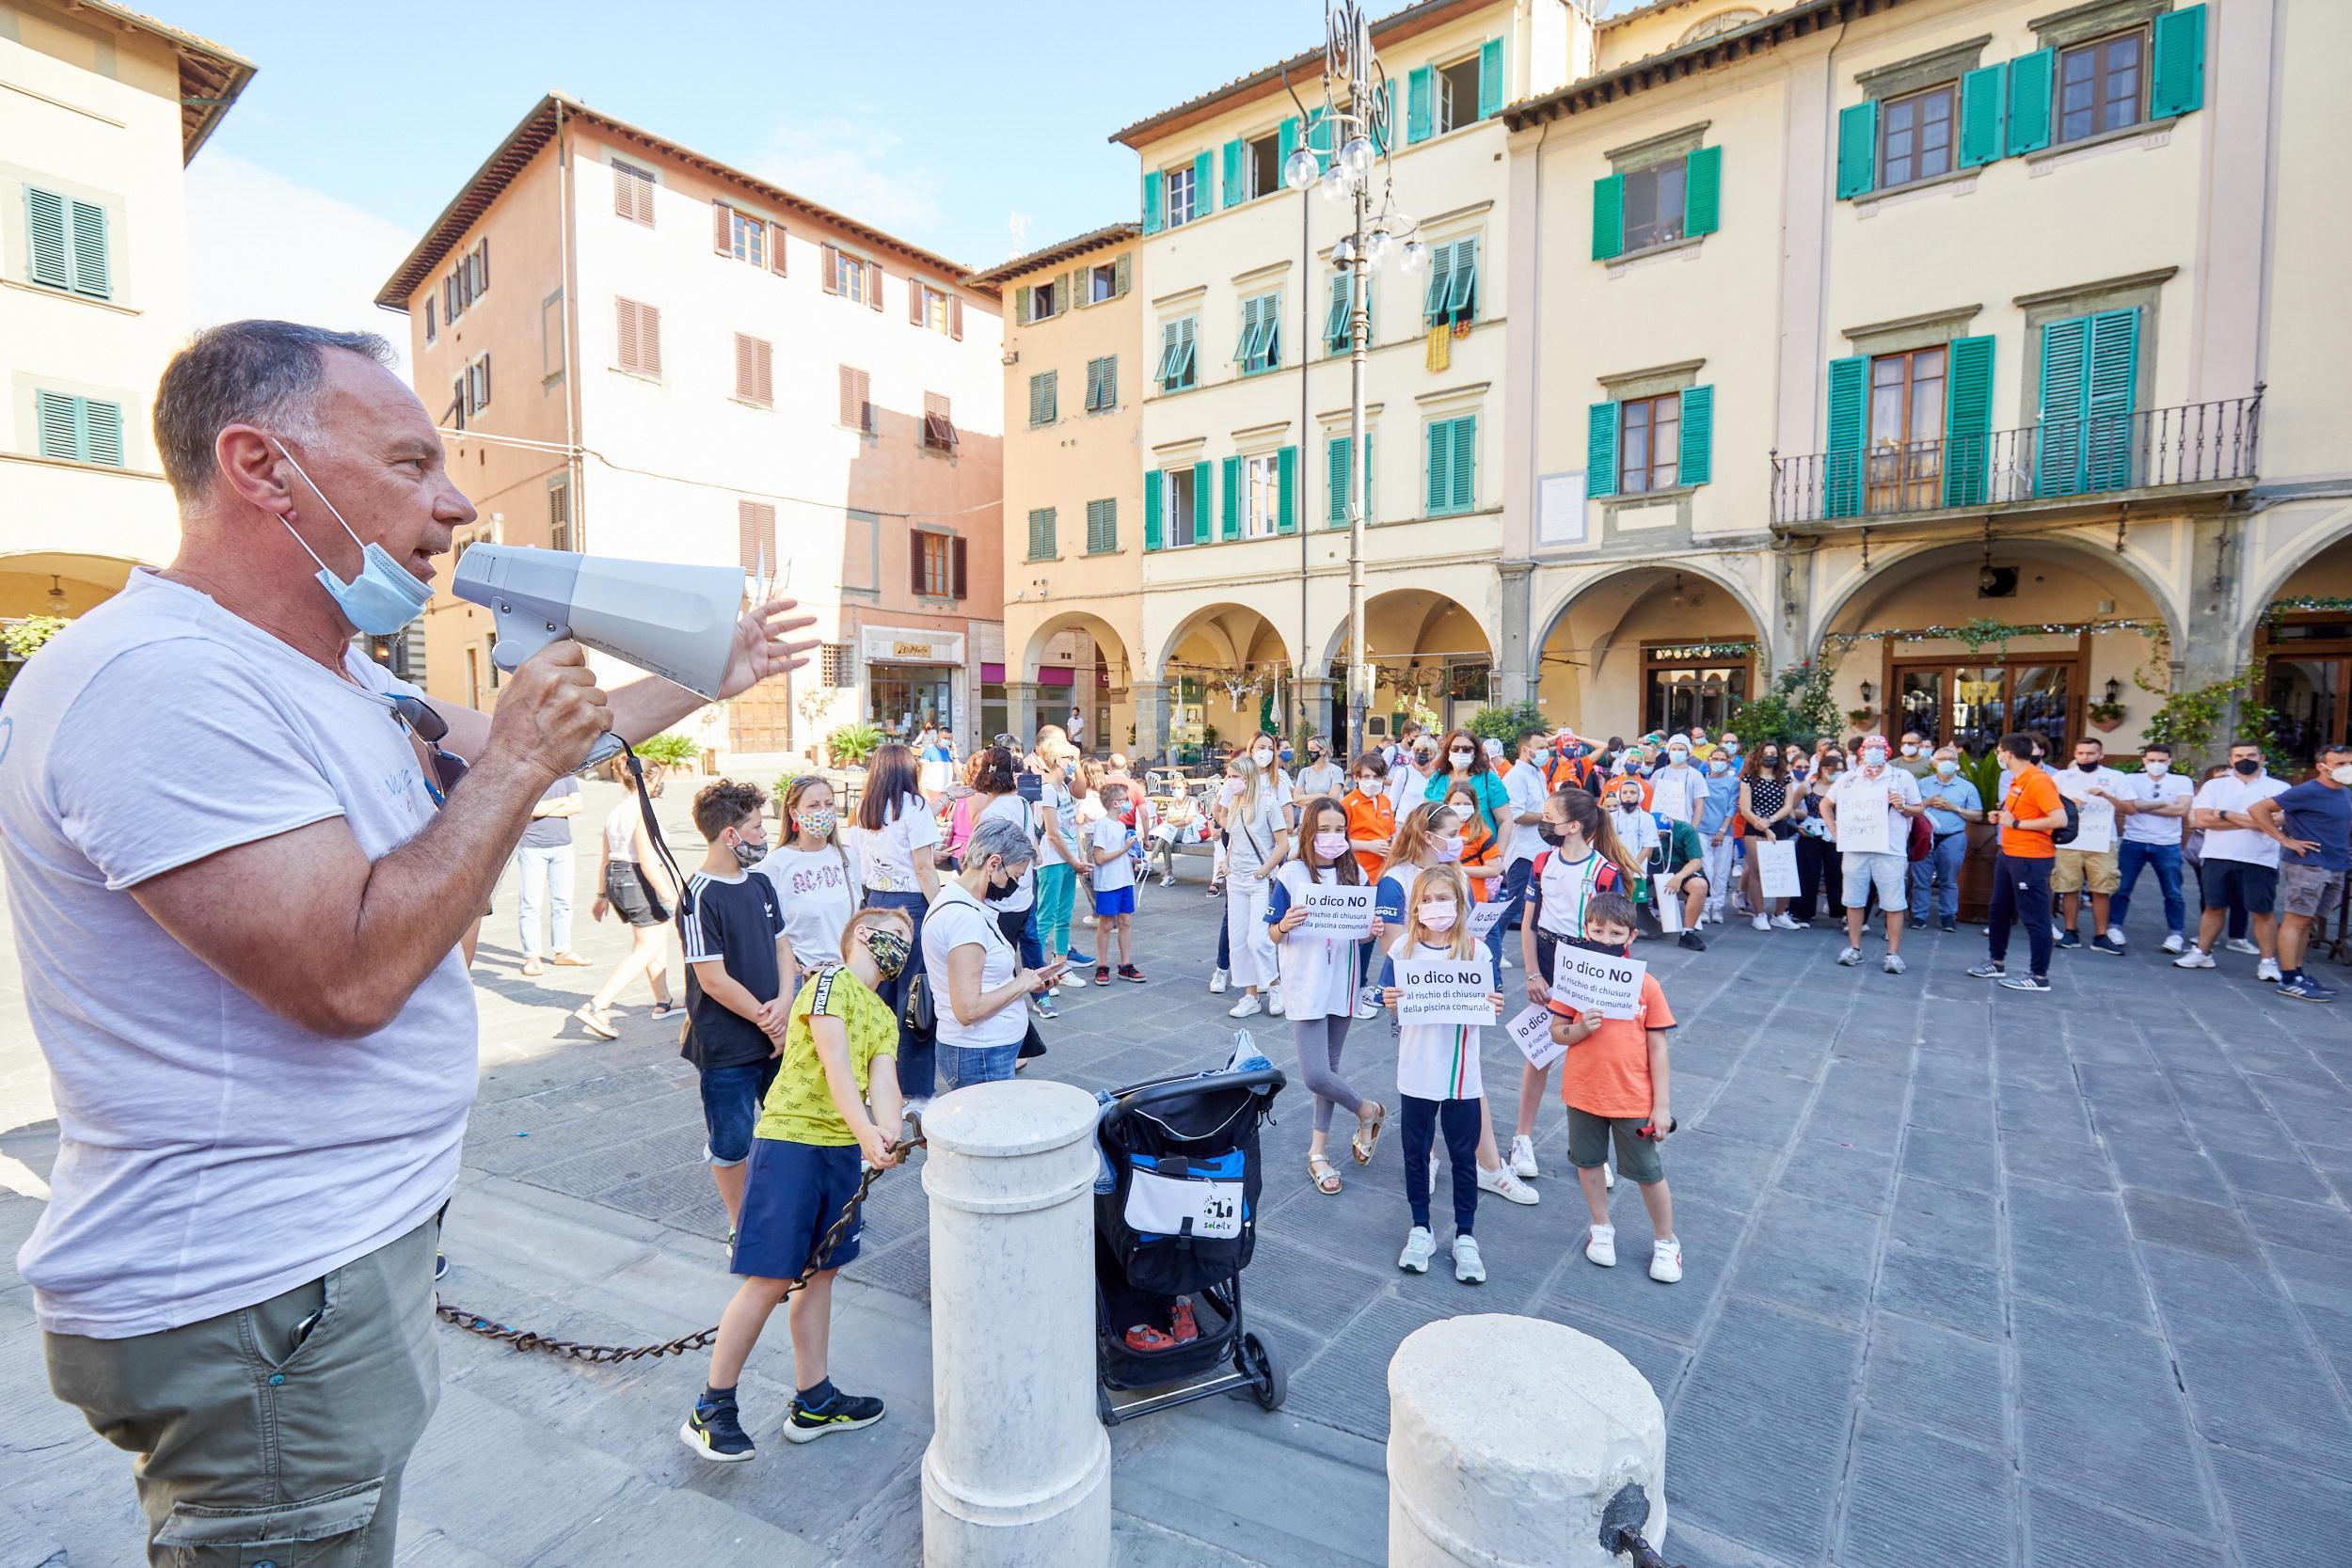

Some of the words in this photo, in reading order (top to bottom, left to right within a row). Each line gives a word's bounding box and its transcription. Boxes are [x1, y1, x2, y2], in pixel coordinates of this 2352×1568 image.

[1305, 895, 1316, 906] Io
[1320, 895, 1344, 907] dico
[1347, 896, 1367, 908] NO
[1406, 973, 1420, 985] Io
[1424, 971, 1454, 984] dico
[1458, 972, 1482, 985] NO
[1563, 956, 1573, 970] Io
[1577, 961, 1605, 978] dico
[1609, 968, 1632, 983] NO
[813, 977, 832, 1015] EVERLAST
[1415, 990, 1441, 1000] rischio
[1557, 984, 1571, 995] della
[1572, 991, 1595, 1004] piscina
[1596, 1000, 1633, 1010] comunale
[1566, 977, 1589, 990] rischio
[1598, 986, 1631, 998] chiusura
[1423, 1004, 1450, 1013] piscina
[1452, 1003, 1490, 1012] comunale
[1518, 1027, 1529, 1037] Io
[1529, 1012, 1549, 1030] dico
[1533, 1030, 1549, 1045] rischio
[1532, 1049, 1544, 1059] della
[1544, 1040, 1554, 1052] pisc
